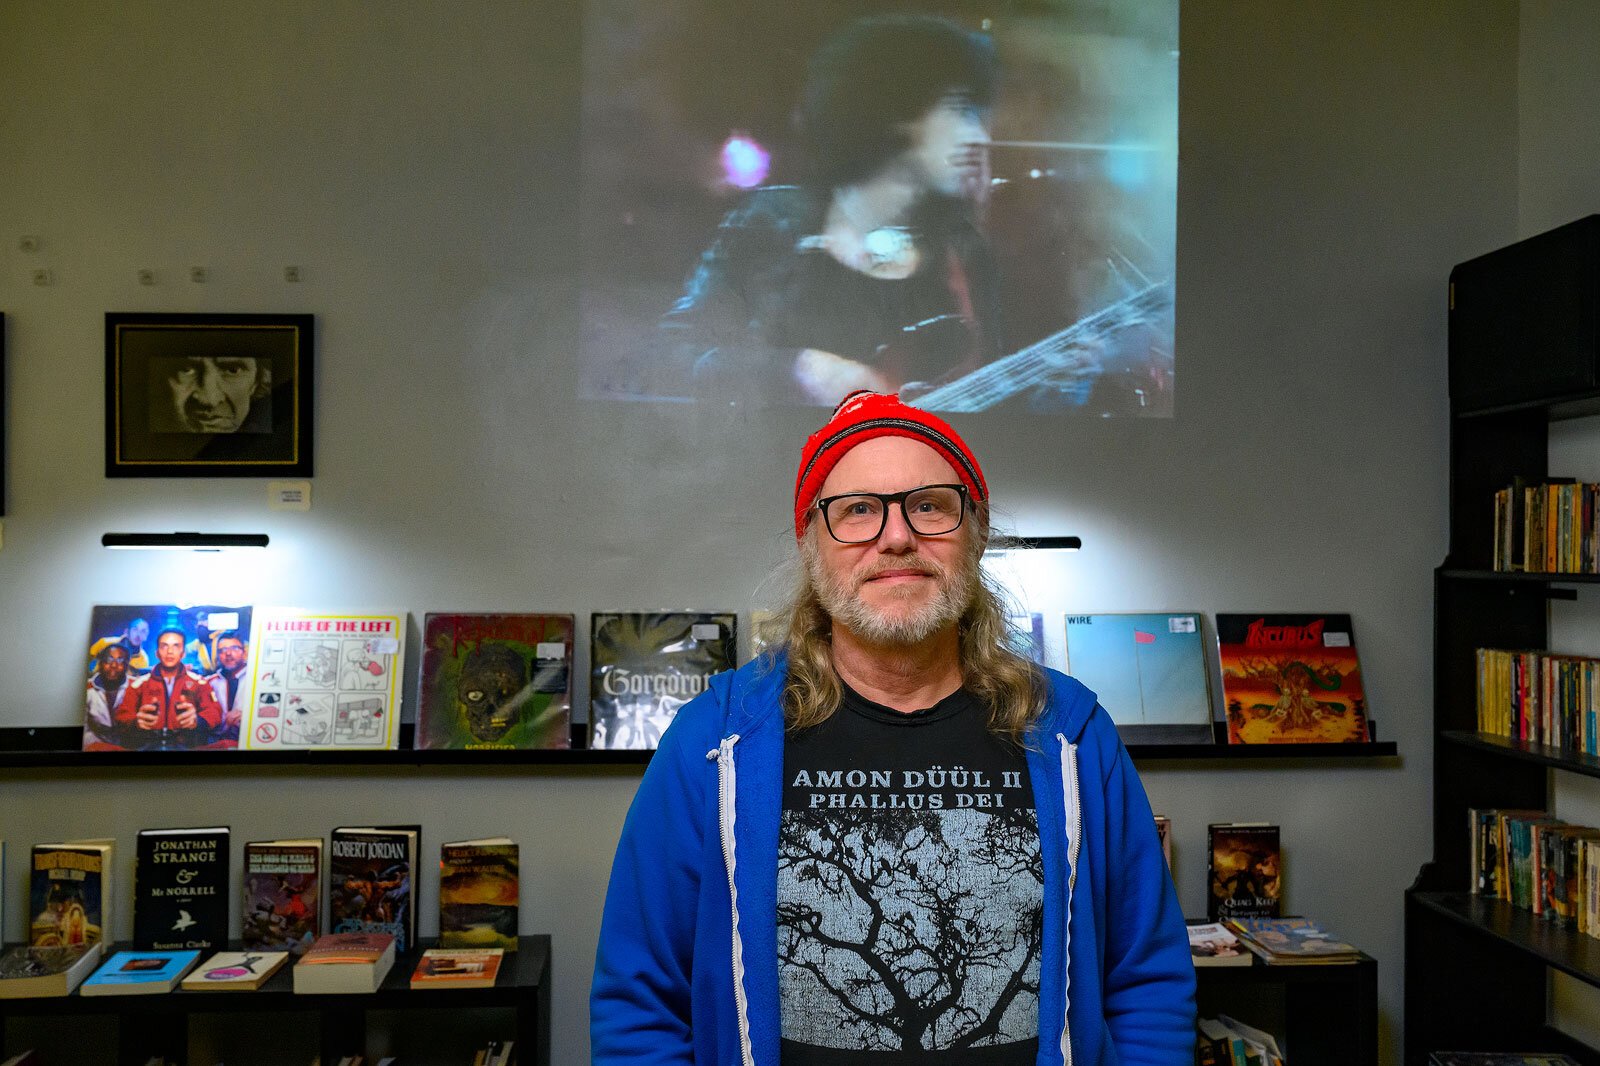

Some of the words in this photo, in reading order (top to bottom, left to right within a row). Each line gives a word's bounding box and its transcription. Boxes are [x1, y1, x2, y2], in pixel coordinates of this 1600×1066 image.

[317, 621, 330, 632] OF
[336, 621, 358, 632] THE
[361, 621, 392, 632] LEFT
[1067, 616, 1092, 625] WIRE
[603, 669, 719, 699] Gorgorot
[792, 769, 893, 789] AMON
[903, 765, 991, 789] DÜÜL
[1002, 771, 1022, 789] II
[808, 793, 944, 809] PHALLUS
[955, 793, 1005, 809] DEI
[153, 840, 218, 852] JONATHAN
[332, 840, 368, 858] ROBERT
[367, 842, 405, 860] JORDAN
[153, 852, 217, 864] STRANGE
[176, 868, 199, 884] &
[166, 886, 216, 896] NORRELL
